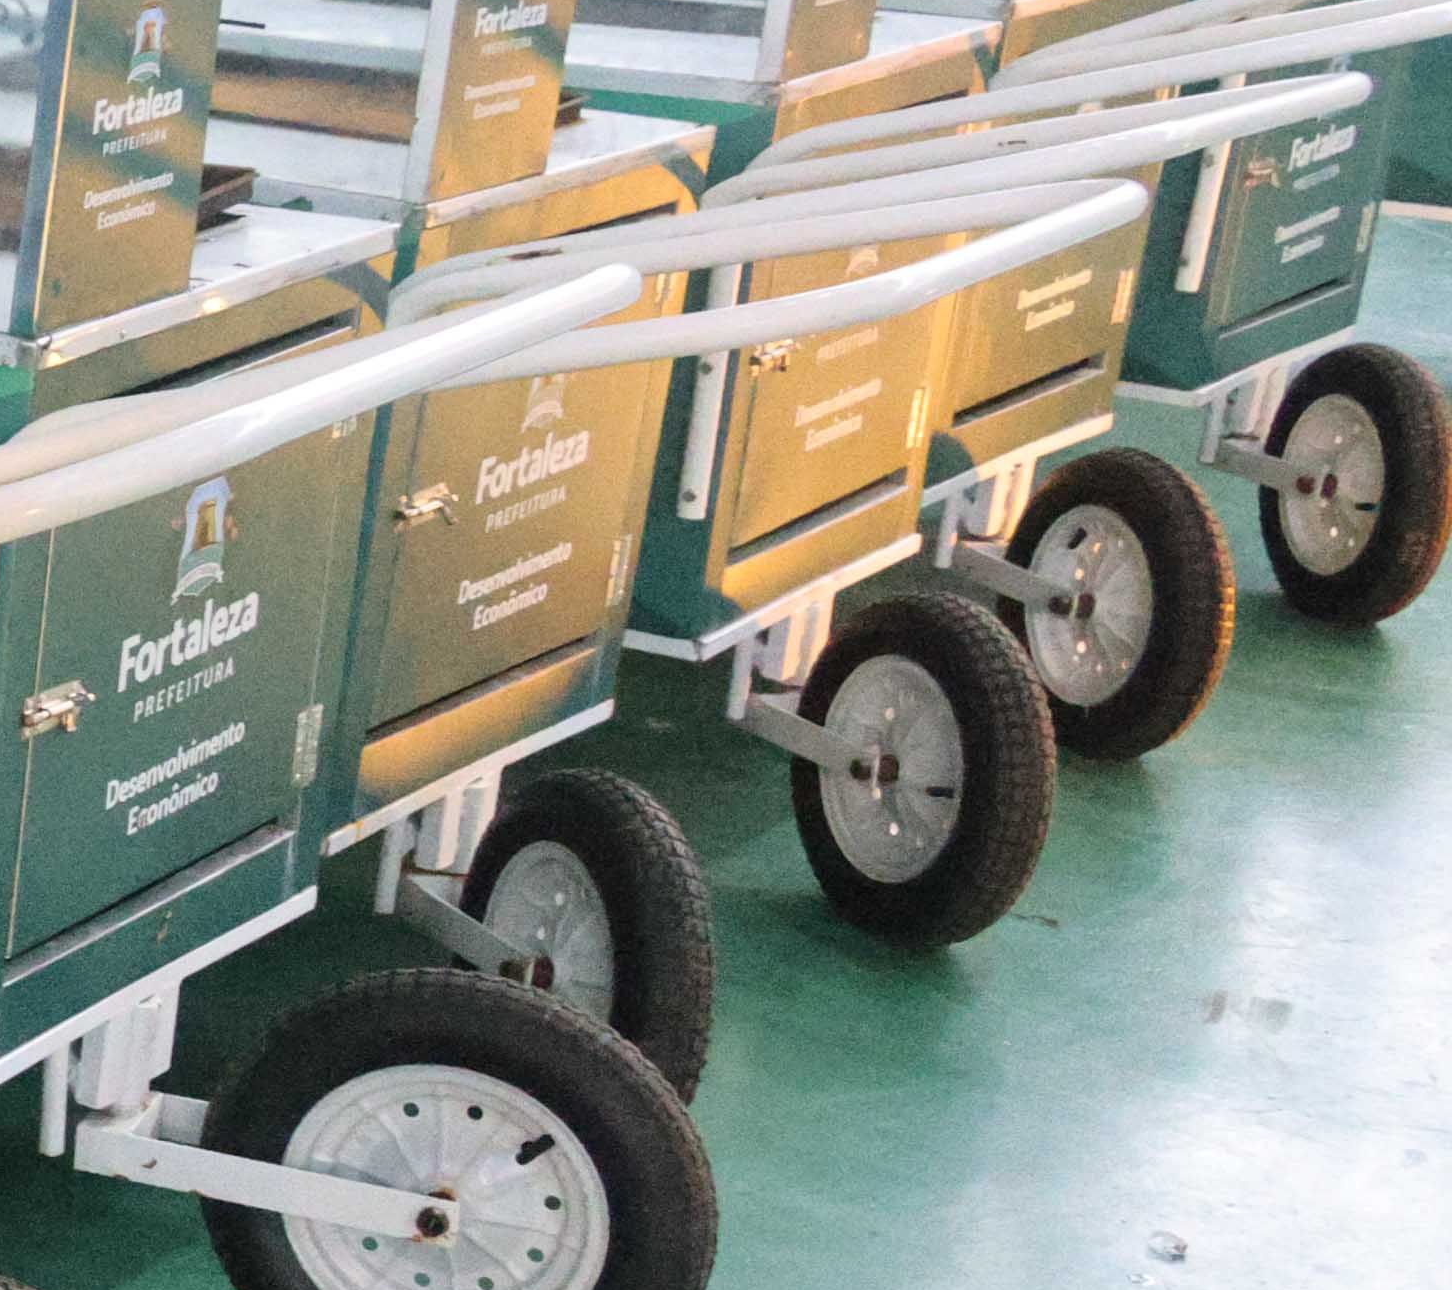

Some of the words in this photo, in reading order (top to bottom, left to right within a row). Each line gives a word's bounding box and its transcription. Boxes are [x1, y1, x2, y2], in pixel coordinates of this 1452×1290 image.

[92, 85, 184, 136] Fortaleza
[475, 428, 591, 506] Fortaleza
[116, 590, 260, 693] Fortaleza
[133, 658, 236, 723] PREFEITURA
[104, 719, 246, 810] Desenvolvimento
[126, 771, 218, 836] Econômico
